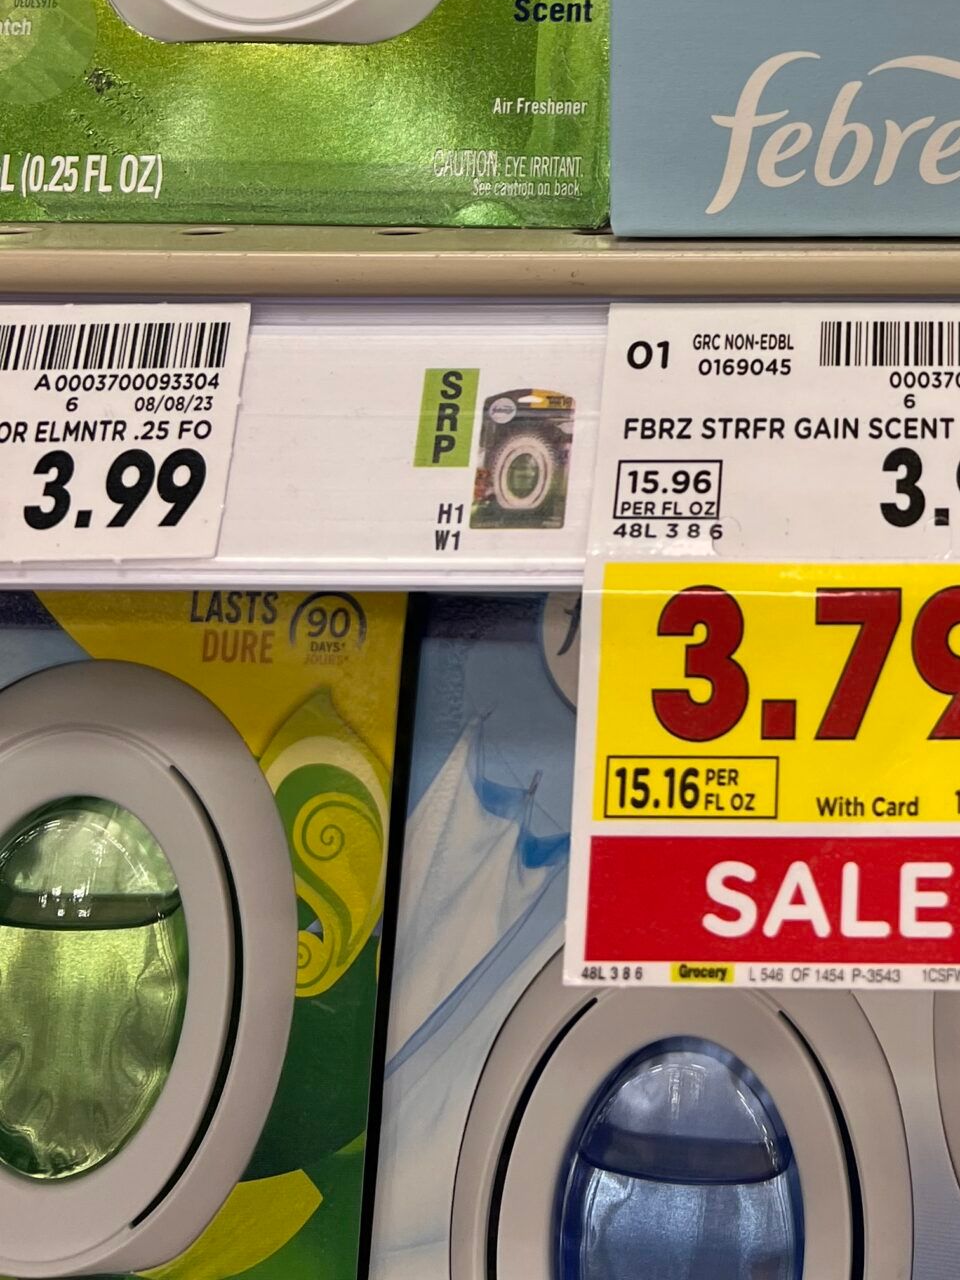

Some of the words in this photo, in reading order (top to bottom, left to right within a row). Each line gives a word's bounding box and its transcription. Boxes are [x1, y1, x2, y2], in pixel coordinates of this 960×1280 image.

[493, 98, 513, 114] Air
[516, 98, 588, 115] Freshener
[22, 152, 79, 198] (0.25
[84, 154, 112, 193] FL
[119, 153, 164, 199] OZ)
[505, 156, 526, 177] EYE
[530, 156, 584, 177] IRRITANT.
[473, 179, 491, 196] See
[495, 180, 534, 196] caution
[537, 183, 549, 196] on
[554, 179, 583, 196] back.
[692, 334, 720, 351] GRC
[724, 334, 794, 351] NON-EDBL
[698, 358, 792, 376] 0169045
[66, 397, 79, 412] 6
[134, 395, 213, 414] 08/08/23
[903, 394, 916, 410] 6
[35, 419, 127, 442] ELMNTR
[134, 420, 169, 440] .25
[178, 420, 212, 440] FO
[623, 418, 692, 440] FBRZ
[701, 418, 785, 440] STRFR
[794, 417, 860, 439] GAIN
[868, 417, 955, 439] SCENT
[24, 448, 207, 530] 3.99
[627, 470, 713, 495] 15.96
[437, 503, 464, 524] H1
[621, 500, 655, 516] PER
[661, 500, 683, 516] FL
[689, 500, 716, 516] OZ
[435, 530, 461, 551] W1
[613, 523, 657, 539] 48L
[190, 590, 279, 625] LASTS
[307, 606, 352, 639] 90
[202, 628, 275, 664] DURE
[614, 767, 700, 810] 15.16
[706, 769, 738, 787] PER
[705, 794, 726, 811] FL
[730, 794, 755, 811] OZ
[817, 797, 865, 817] With
[872, 797, 919, 817] Card
[702, 860, 953, 938] SALE
[581, 967, 605, 980] 48L
[679, 964, 728, 982] Grocery
[748, 969, 756, 982] L
[761, 969, 783, 982] 546
[791, 969, 810, 982] OF
[815, 969, 844, 982] 1454
[852, 969, 900, 983] P-3543
